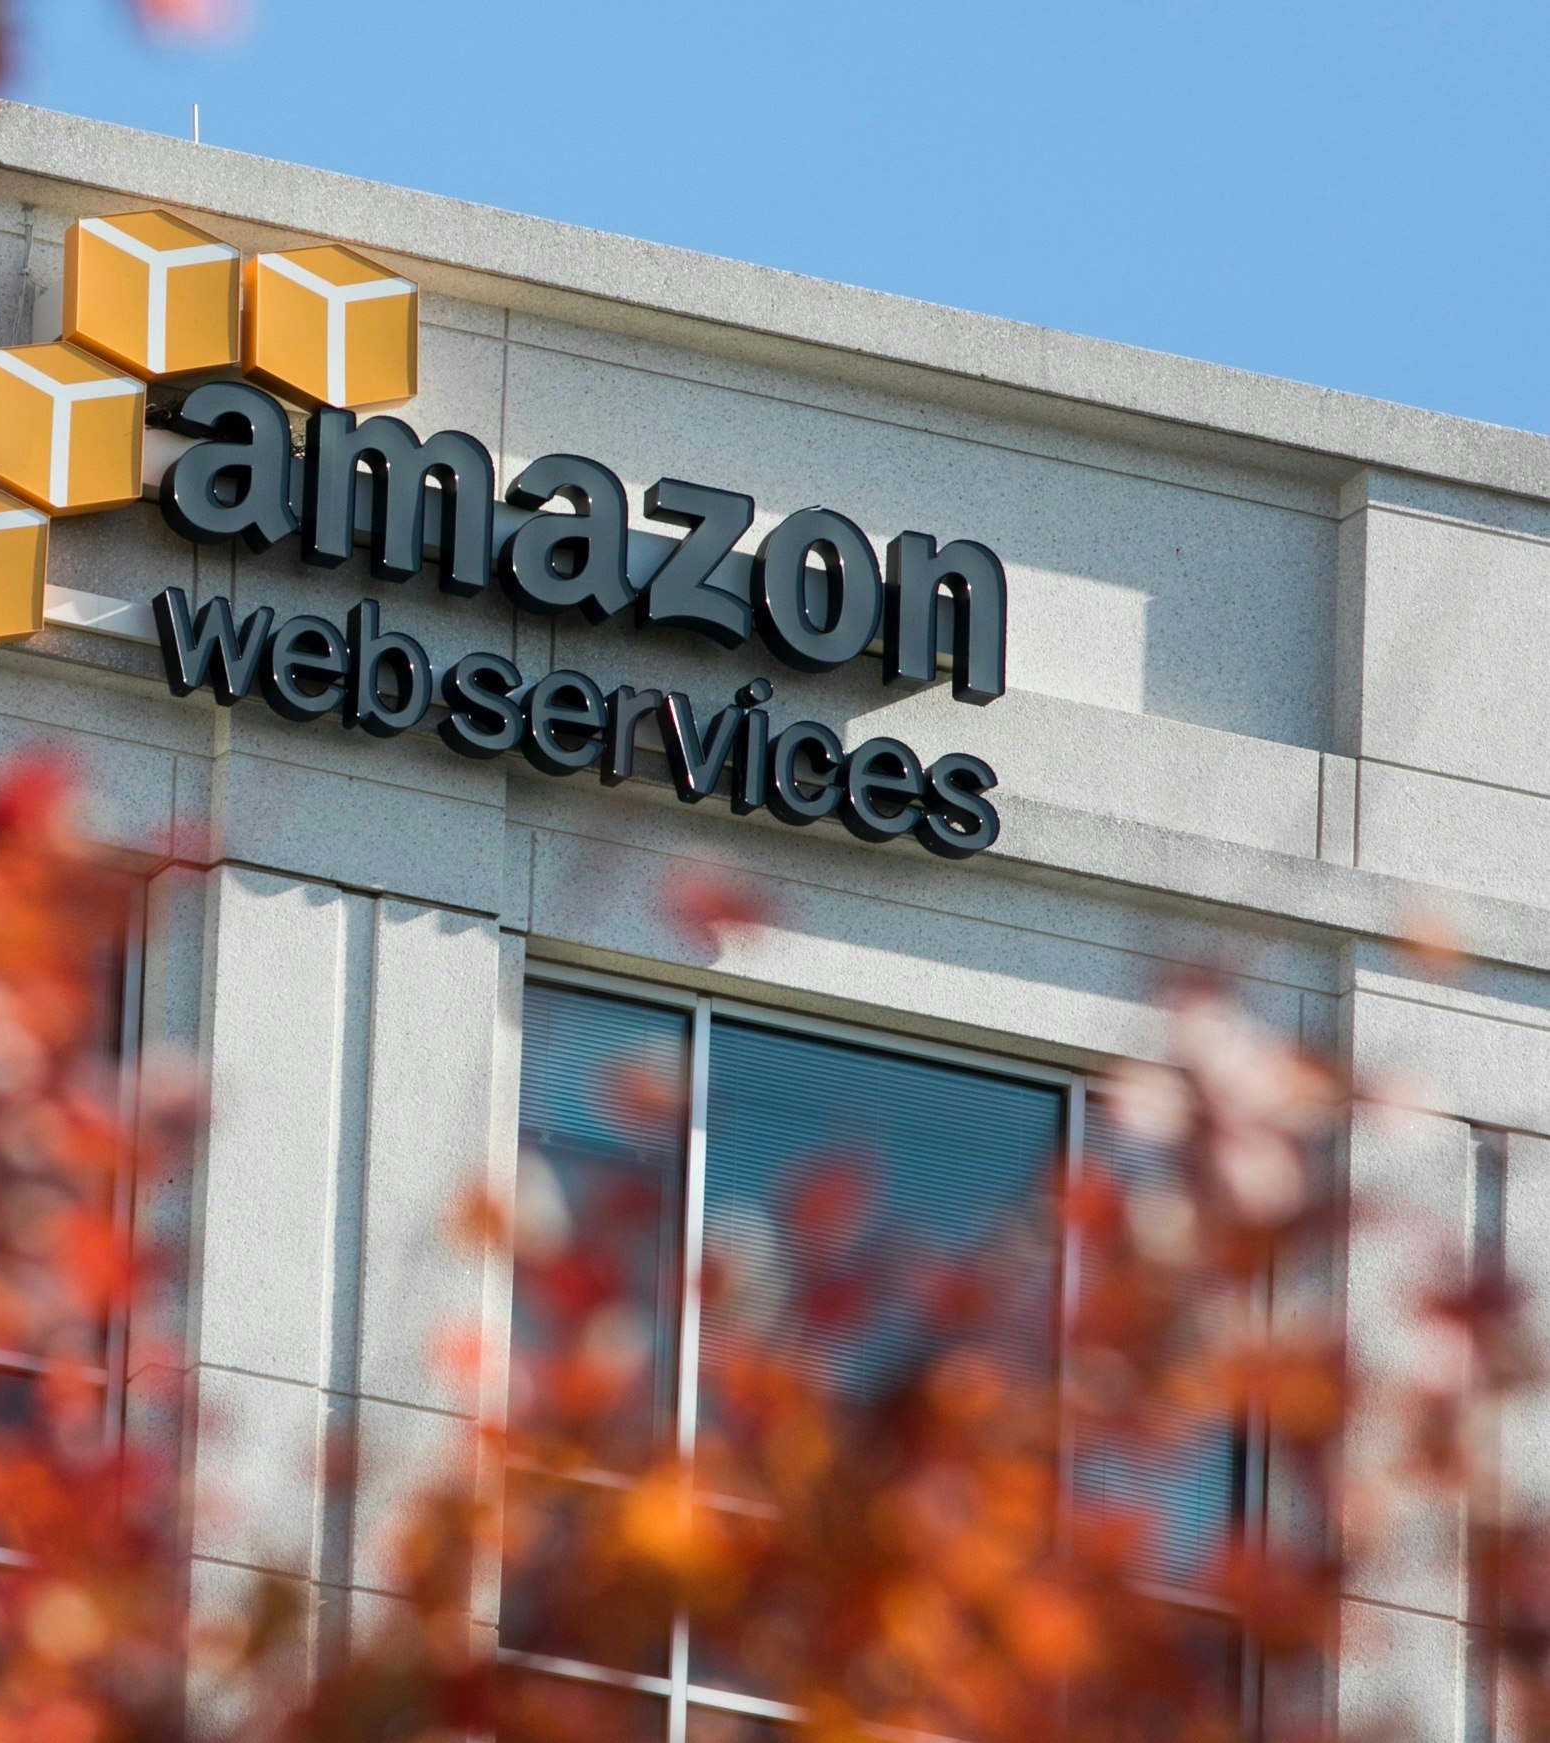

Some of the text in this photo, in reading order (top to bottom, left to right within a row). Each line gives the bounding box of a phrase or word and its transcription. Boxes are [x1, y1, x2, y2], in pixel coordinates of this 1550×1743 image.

[159, 382, 1008, 706] amazon
[153, 586, 1001, 859] web services
